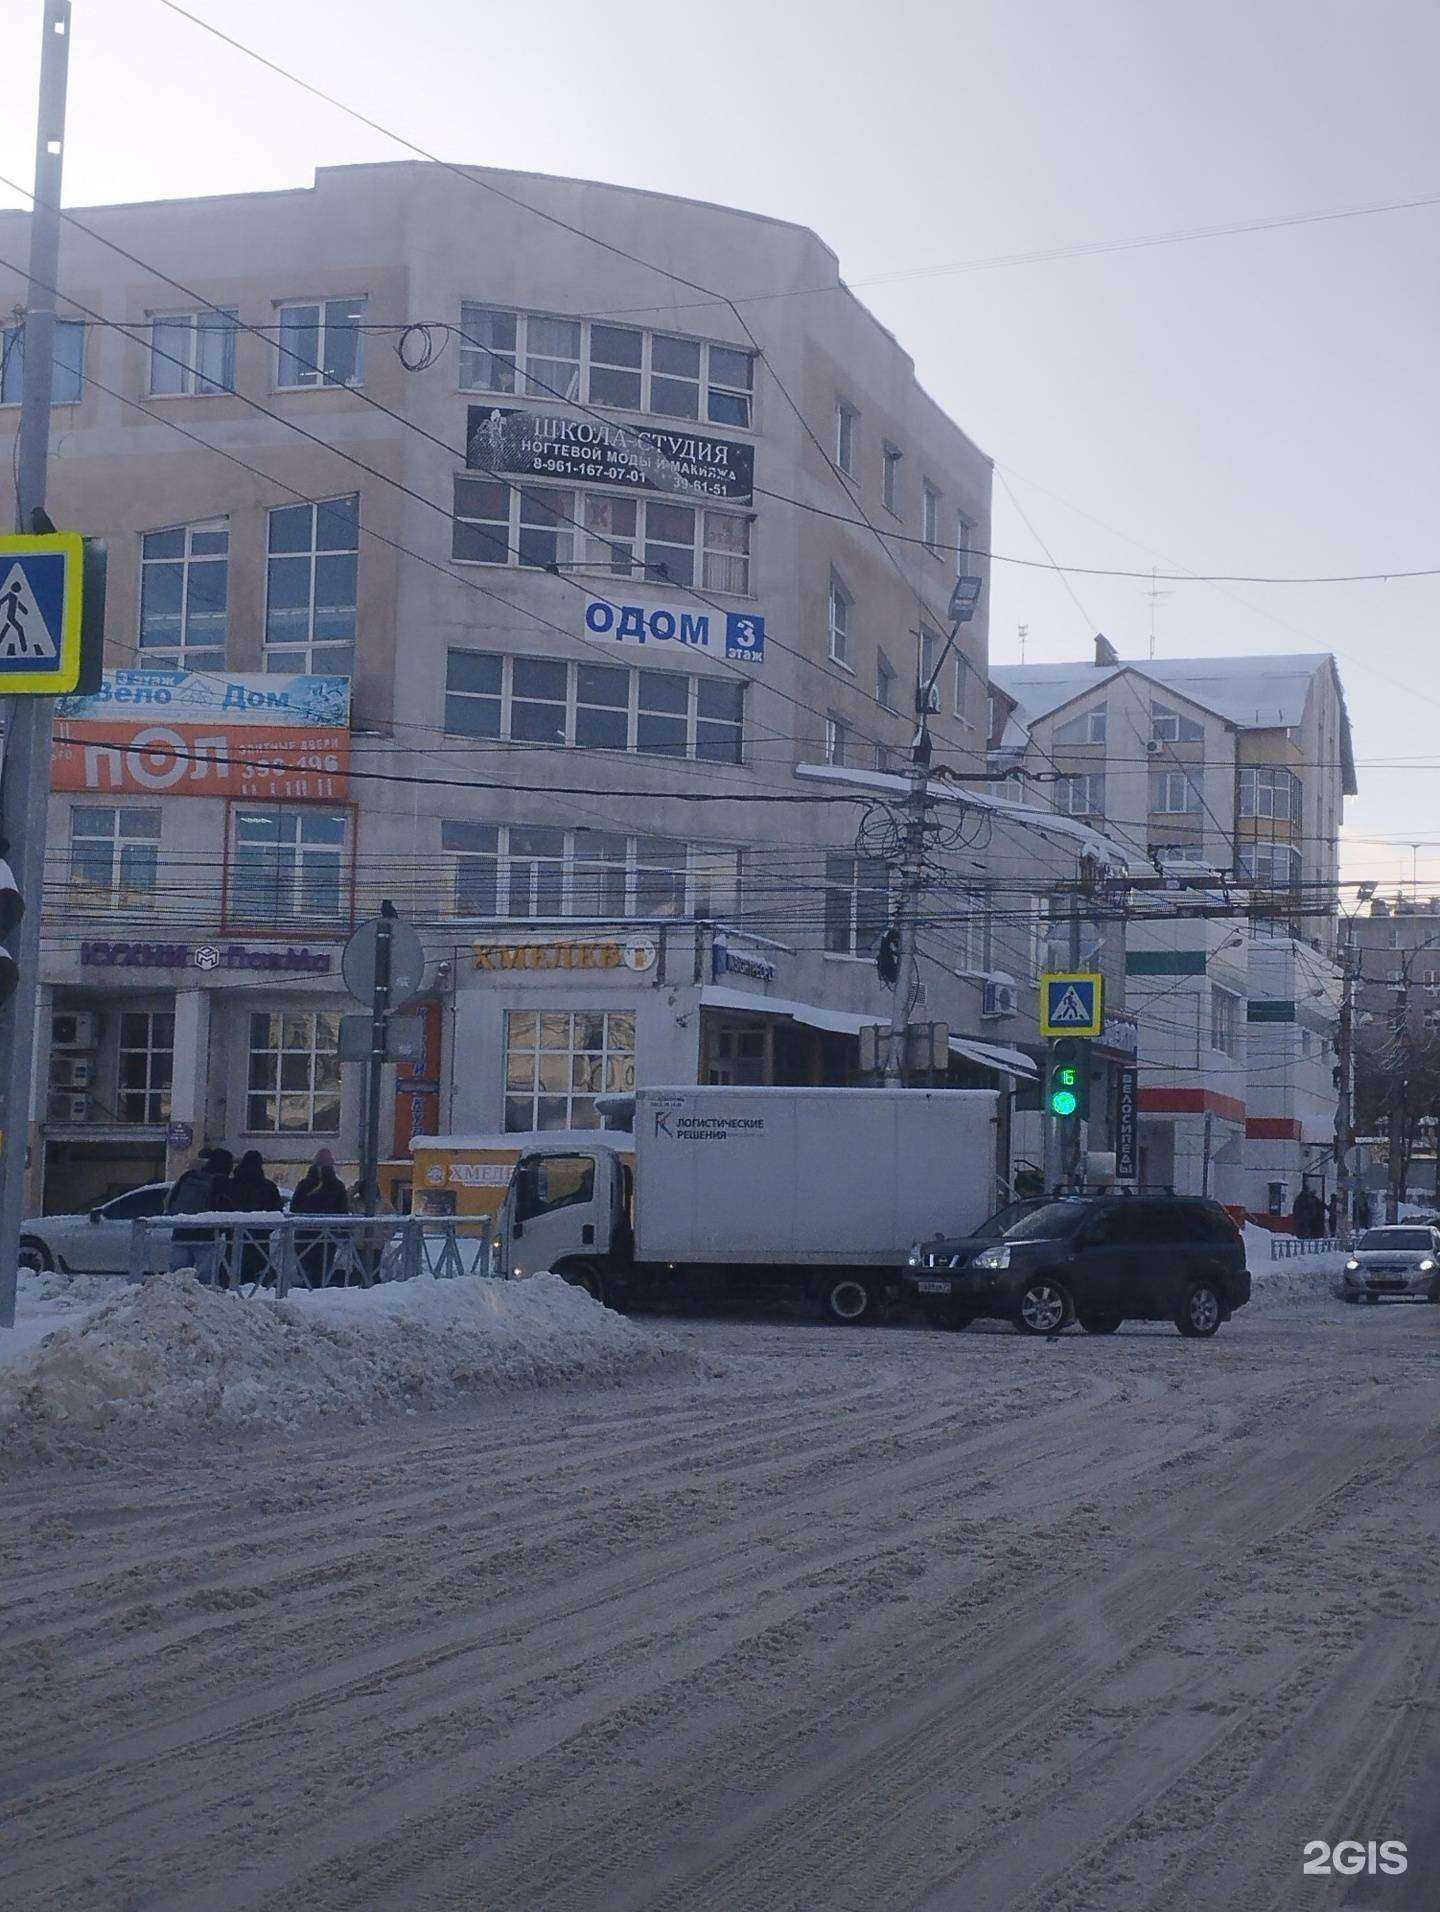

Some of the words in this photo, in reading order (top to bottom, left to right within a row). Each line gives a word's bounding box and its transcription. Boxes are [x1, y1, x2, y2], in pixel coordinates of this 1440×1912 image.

[521, 440, 602, 460] НОГТЕВОЙ
[606, 451, 651, 468] МОДЫ
[534, 417, 729, 464] ШКОЛА-СТУДИЯ
[533, 457, 646, 483] 8-961-167-07-01
[673, 477, 728, 496] 39-61-51
[585, 602, 710, 646] ОДОМ
[736, 620, 757, 647] 3
[728, 647, 764, 663] этаж
[222, 683, 290, 711] Дом
[676, 1118, 765, 1129] ЛОГИСТИЧЕСКИЕ
[676, 1129, 728, 1141] РЕШЕНИЯ
[1119, 1073, 1134, 1174] ВЕЛОСИПЕДЫ
